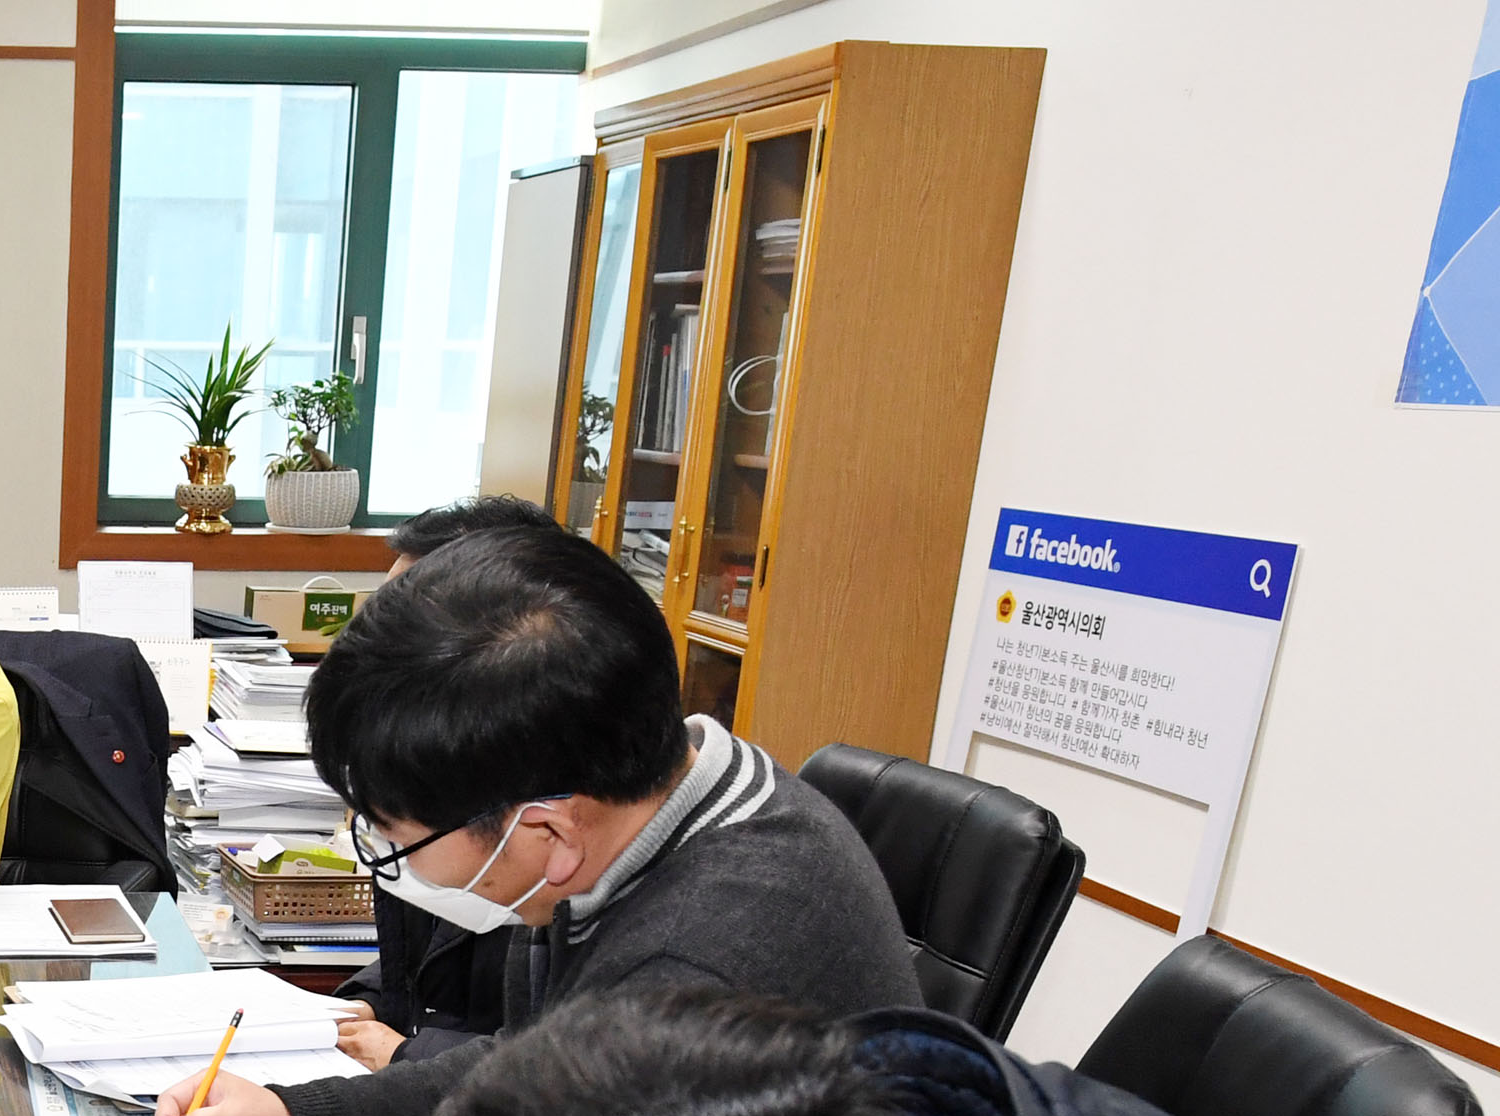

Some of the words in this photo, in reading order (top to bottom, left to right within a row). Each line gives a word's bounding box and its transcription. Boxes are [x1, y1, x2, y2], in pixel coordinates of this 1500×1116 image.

[1022, 601, 1106, 640] 울산광역시의회
[992, 659, 1068, 690] #울산청년기본소득
[1069, 677, 1089, 695] 함께
[1091, 683, 1148, 711] 만들어갑시다
[996, 636, 1014, 654] 나는
[1017, 640, 1069, 666] 청년기본소득
[1070, 653, 1088, 672] 주는
[1091, 658, 1129, 682] 울산시를
[1130, 667, 1176, 692] 희망한다!
[980, 711, 1022, 735] #낭비예산
[1023, 722, 1059, 746] 절약해서
[1061, 733, 1098, 758] 청년예산
[984, 694, 1025, 716] #울산시가
[1026, 704, 1053, 723] 청년의
[1054, 711, 1073, 731] 꿈을
[1074, 717, 1122, 744] 응원합니다
[988, 676, 1021, 698] #청년을
[1021, 684, 1067, 707] 응원합니다
[1081, 700, 1119, 722] 함께가자
[1121, 710, 1141, 730] 청춘
[1146, 719, 1185, 742] #힘내라
[1187, 727, 1209, 750] 청년
